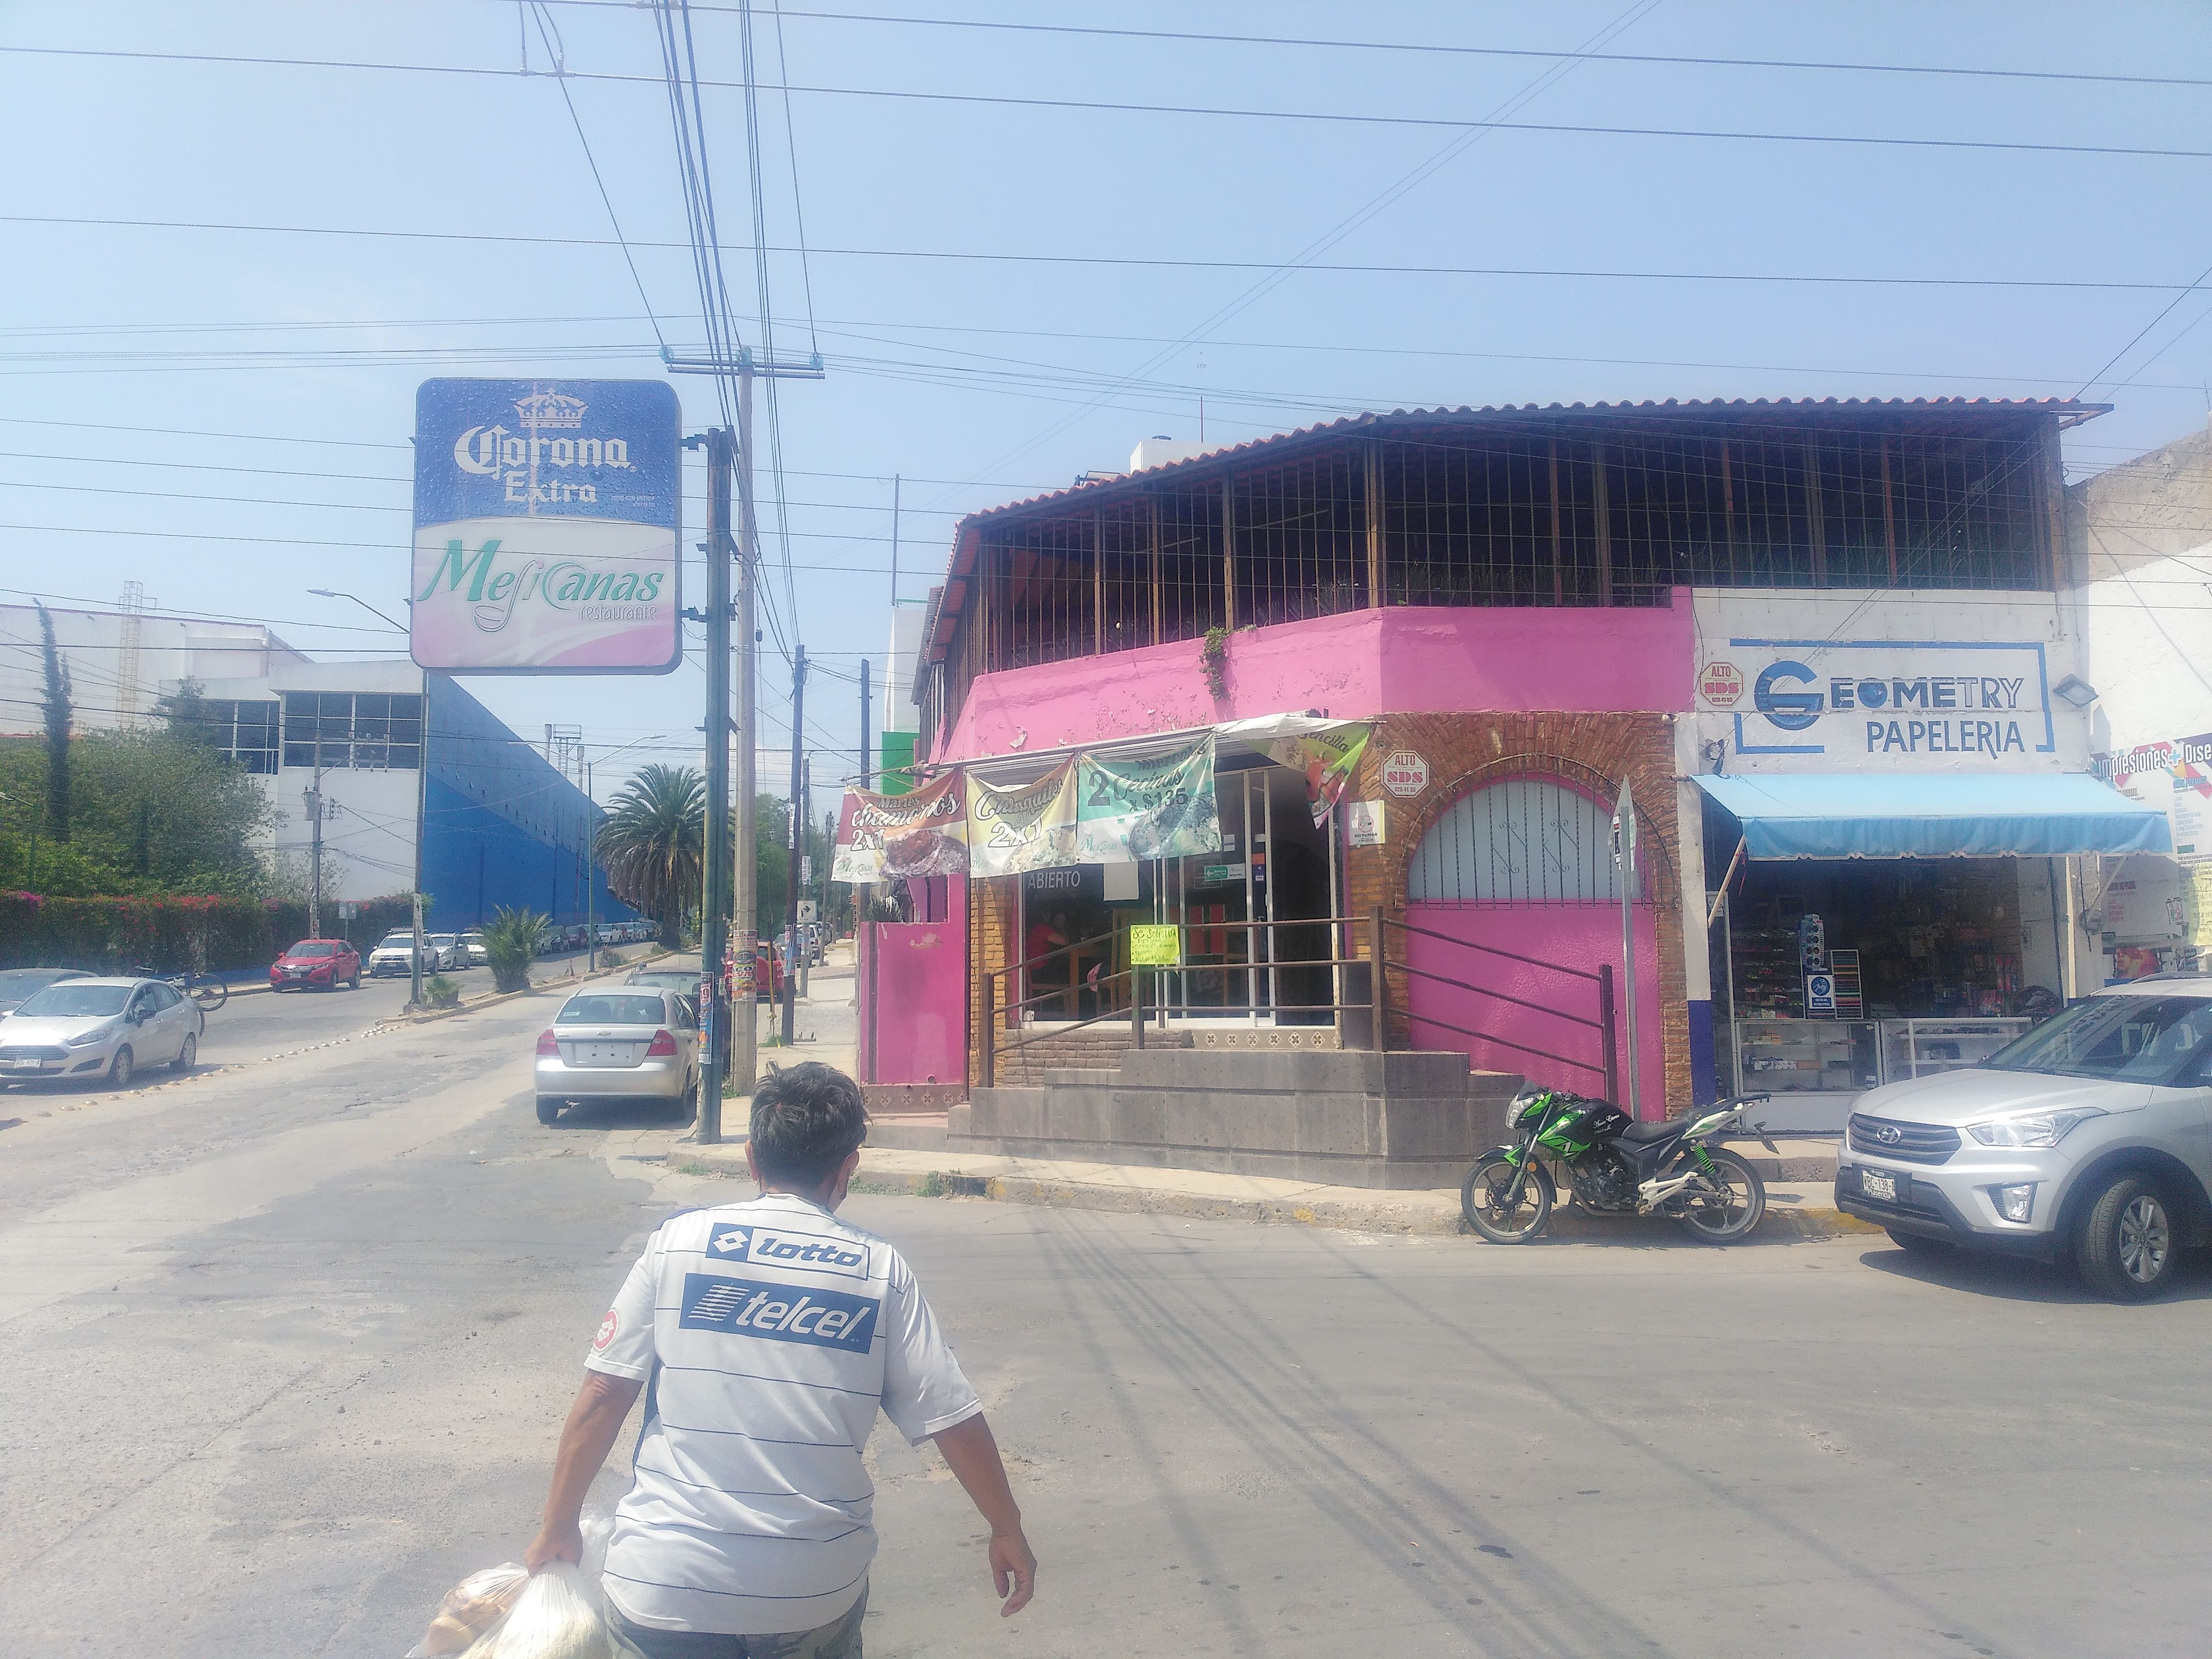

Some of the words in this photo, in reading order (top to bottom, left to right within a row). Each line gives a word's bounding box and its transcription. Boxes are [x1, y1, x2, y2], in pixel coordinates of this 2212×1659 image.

[454, 424, 632, 479] Corona
[504, 470, 598, 502] Extra
[579, 604, 657, 621] restaurante
[1711, 666, 1731, 677] ALTO
[1705, 682, 1739, 694] SDS
[1866, 720, 2025, 759] PAPELERIA
[1395, 755, 1415, 766] ALTO
[1387, 771, 1423, 783] SDS
[1088, 770, 1110, 807] 2
[878, 796, 921, 808] Martes
[1142, 787, 1189, 812] $135
[851, 828, 886, 852] 2x1
[1027, 871, 1081, 889] ABIERTO
[1133, 927, 1144, 939] Se
[1867, 1189, 1891, 1199] Plasencia
[756, 1238, 862, 1266] lotto
[735, 1291, 871, 1340] telcel
